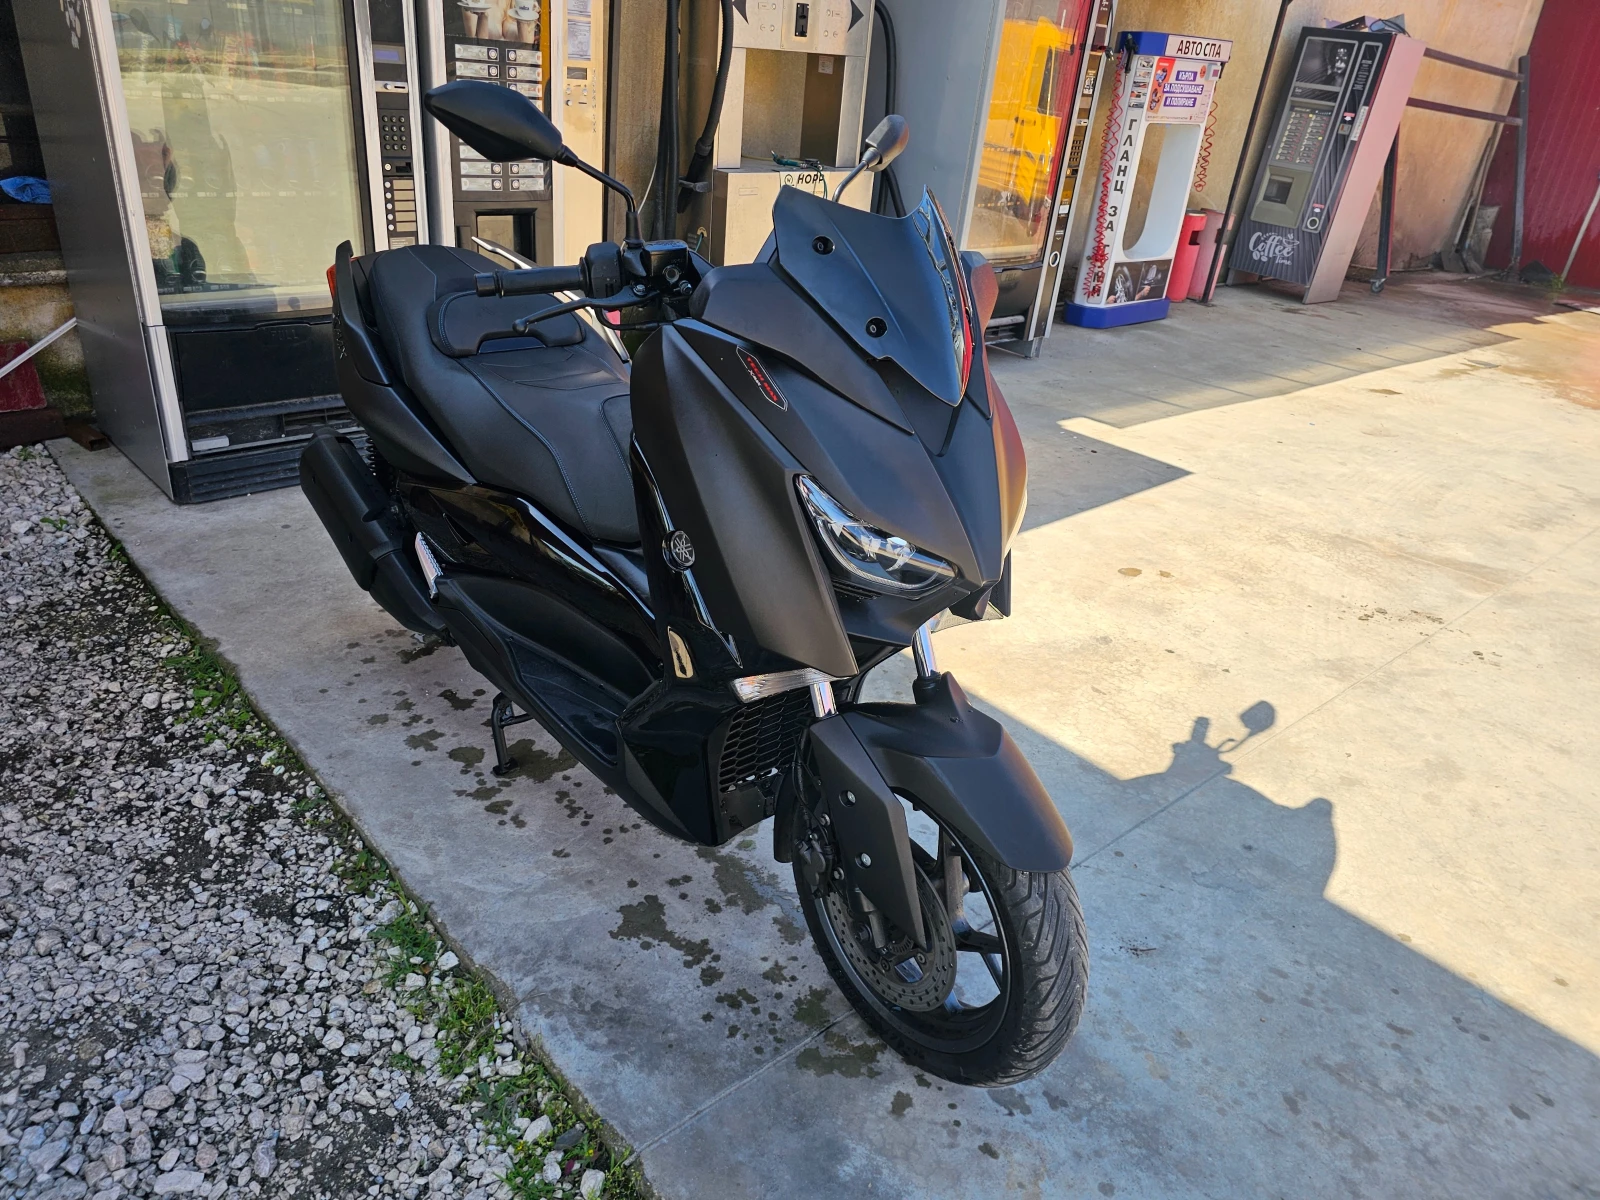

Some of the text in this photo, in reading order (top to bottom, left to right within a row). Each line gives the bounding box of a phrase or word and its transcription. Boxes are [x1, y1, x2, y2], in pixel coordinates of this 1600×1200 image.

[1176, 40, 1222, 58] АВТО СПА
[1178, 71, 1195, 81] КЪРПА
[1163, 83, 1203, 94] ЗА ПОДСУШАВАНЕ
[1171, 97, 1195, 107] ПОЛИРАНЕ
[1114, 118, 1138, 195] ГЛАНЦ
[1105, 205, 1118, 232] ЗА
[1248, 231, 1294, 258] Coffee
[1275, 255, 1293, 266] Time
[746, 356, 778, 402] TECH MAX
